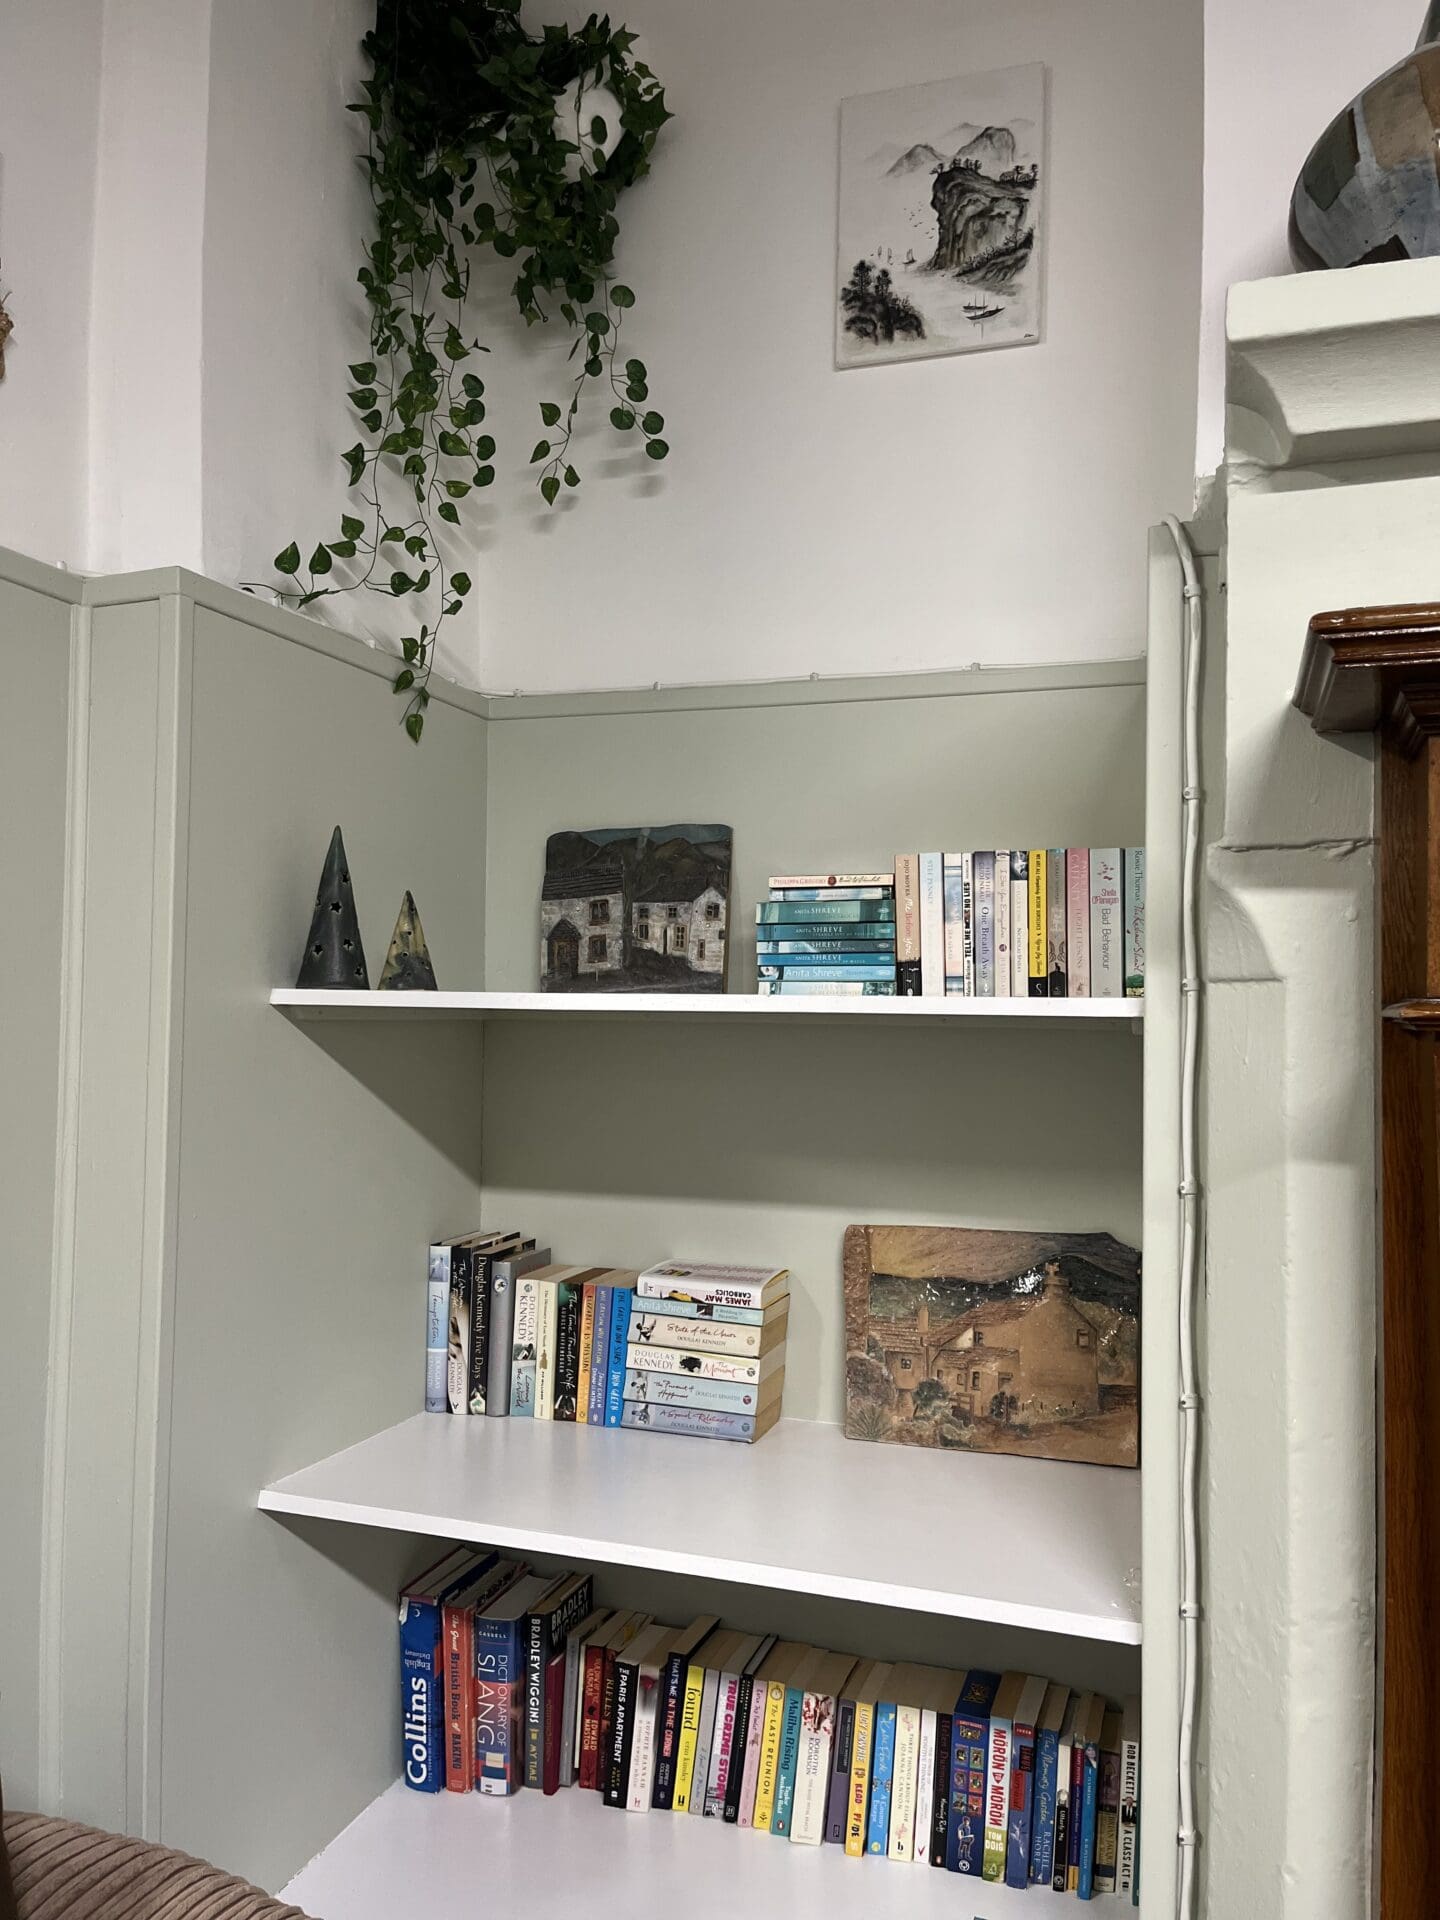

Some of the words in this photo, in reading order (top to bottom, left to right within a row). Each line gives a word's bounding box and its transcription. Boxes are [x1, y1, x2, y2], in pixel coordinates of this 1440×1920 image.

[1134, 850, 1142, 870] Rosie
[964, 898, 970, 909] NO
[981, 907, 989, 924] One
[1101, 908, 1111, 926] Bad
[965, 930, 971, 938] ME
[981, 927, 989, 954] Breath
[904, 938, 912, 955] You
[964, 940, 972, 958] TELL
[1102, 928, 1111, 971] Behaviour
[785, 969, 810, 977] Anita
[813, 969, 842, 977] Shreve
[980, 957, 989, 980] Away
[458, 1259, 466, 1276] The
[473, 1256, 487, 1293] Douglas
[458, 1277, 466, 1310] Woman
[704, 1294, 724, 1304] MAY
[715, 1289, 751, 1298] CARBOLICS
[725, 1297, 752, 1306] JAMES
[430, 1289, 444, 1344] Temptation
[475, 1294, 486, 1334] Kennedy
[518, 1295, 528, 1341] KENNEDY
[637, 1300, 661, 1310] Anita
[663, 1301, 692, 1314] Shreve
[528, 1296, 536, 1342] DOUGLAS
[475, 1336, 484, 1354] Five
[702, 1338, 726, 1346] KENNEDY
[582, 1343, 591, 1373] MISSING
[633, 1357, 674, 1370] KENNEDY
[634, 1349, 675, 1360] DOUGLAS
[472, 1357, 484, 1379] Days
[611, 1369, 621, 1386] JOHN
[703, 1363, 744, 1377] Moment
[515, 1381, 524, 1408] World
[663, 1380, 688, 1390] Pursuit
[695, 1390, 717, 1399] DOUGLAS
[718, 1393, 741, 1401] KENNEDY
[610, 1388, 620, 1411] GREEN
[670, 1421, 695, 1429] DOUGLAS
[696, 1424, 720, 1432] KENNEDY
[692, 1413, 736, 1425] Relationship
[450, 1630, 459, 1652] Great
[478, 1631, 508, 1639] CASSELL
[530, 1619, 541, 1669] BRADLEY
[404, 1658, 431, 1670] English
[405, 1649, 431, 1659] Dictionary
[450, 1653, 460, 1690] British
[671, 1658, 679, 1685] THAT'S
[478, 1653, 495, 1746] SLANG
[497, 1654, 508, 1729] DICTIONARY
[529, 1671, 539, 1723] WIGGINS
[605, 1678, 614, 1717] RIFLES
[618, 1674, 627, 1702] PARIS
[669, 1685, 677, 1697] ME
[725, 1679, 738, 1711] TRUE
[451, 1693, 460, 1720] Book
[668, 1698, 677, 1709] IN
[683, 1687, 701, 1731] found
[770, 1704, 778, 1716] The
[451, 1722, 460, 1732] of
[666, 1710, 676, 1728] THE
[786, 1699, 799, 1735] Malibu
[860, 1708, 868, 1729] LUCY
[405, 1677, 427, 1784] Collins
[498, 1731, 508, 1746] OF
[614, 1704, 625, 1763] APARTMENT
[643, 1720, 651, 1750] SOPHIE
[721, 1713, 735, 1755] CRIME
[768, 1719, 776, 1743] LAST
[452, 1733, 462, 1769] BAKING
[529, 1744, 537, 1759] MY
[663, 1729, 673, 1758] CORNER
[781, 1737, 794, 1770] Rising
[992, 1728, 1007, 1770] MÖRÖN
[1045, 1735, 1056, 1751] The
[1127, 1744, 1136, 1759] ROB
[805, 1737, 814, 1775] KOOMSON
[812, 1738, 821, 1776] DOROTHY
[529, 1760, 538, 1781] TIME
[640, 1754, 649, 1789] HANNAH
[716, 1758, 728, 1801] STORY
[763, 1747, 774, 1795] REUNION
[939, 1750, 948, 1793] Dunmore
[1041, 1752, 1055, 1789] Memory
[1125, 1762, 1136, 1795] BECKETT
[778, 1774, 786, 1798] Jenkins
[897, 1776, 905, 1810] CANNON
[777, 1799, 785, 1814] Reid
[877, 1801, 885, 1829] Country
[1035, 1791, 1051, 1824] Garden
[1058, 1810, 1066, 1831] Utterly
[985, 1840, 1004, 1851] DOIG
[988, 1831, 1002, 1842] TOM
[1058, 1832, 1064, 1842] Me
[1034, 1836, 1042, 1863] HORE
[1041, 1831, 1051, 1869] RACHEL
[1123, 1837, 1131, 1861] CLASS
[1122, 1863, 1130, 1878] ACT
